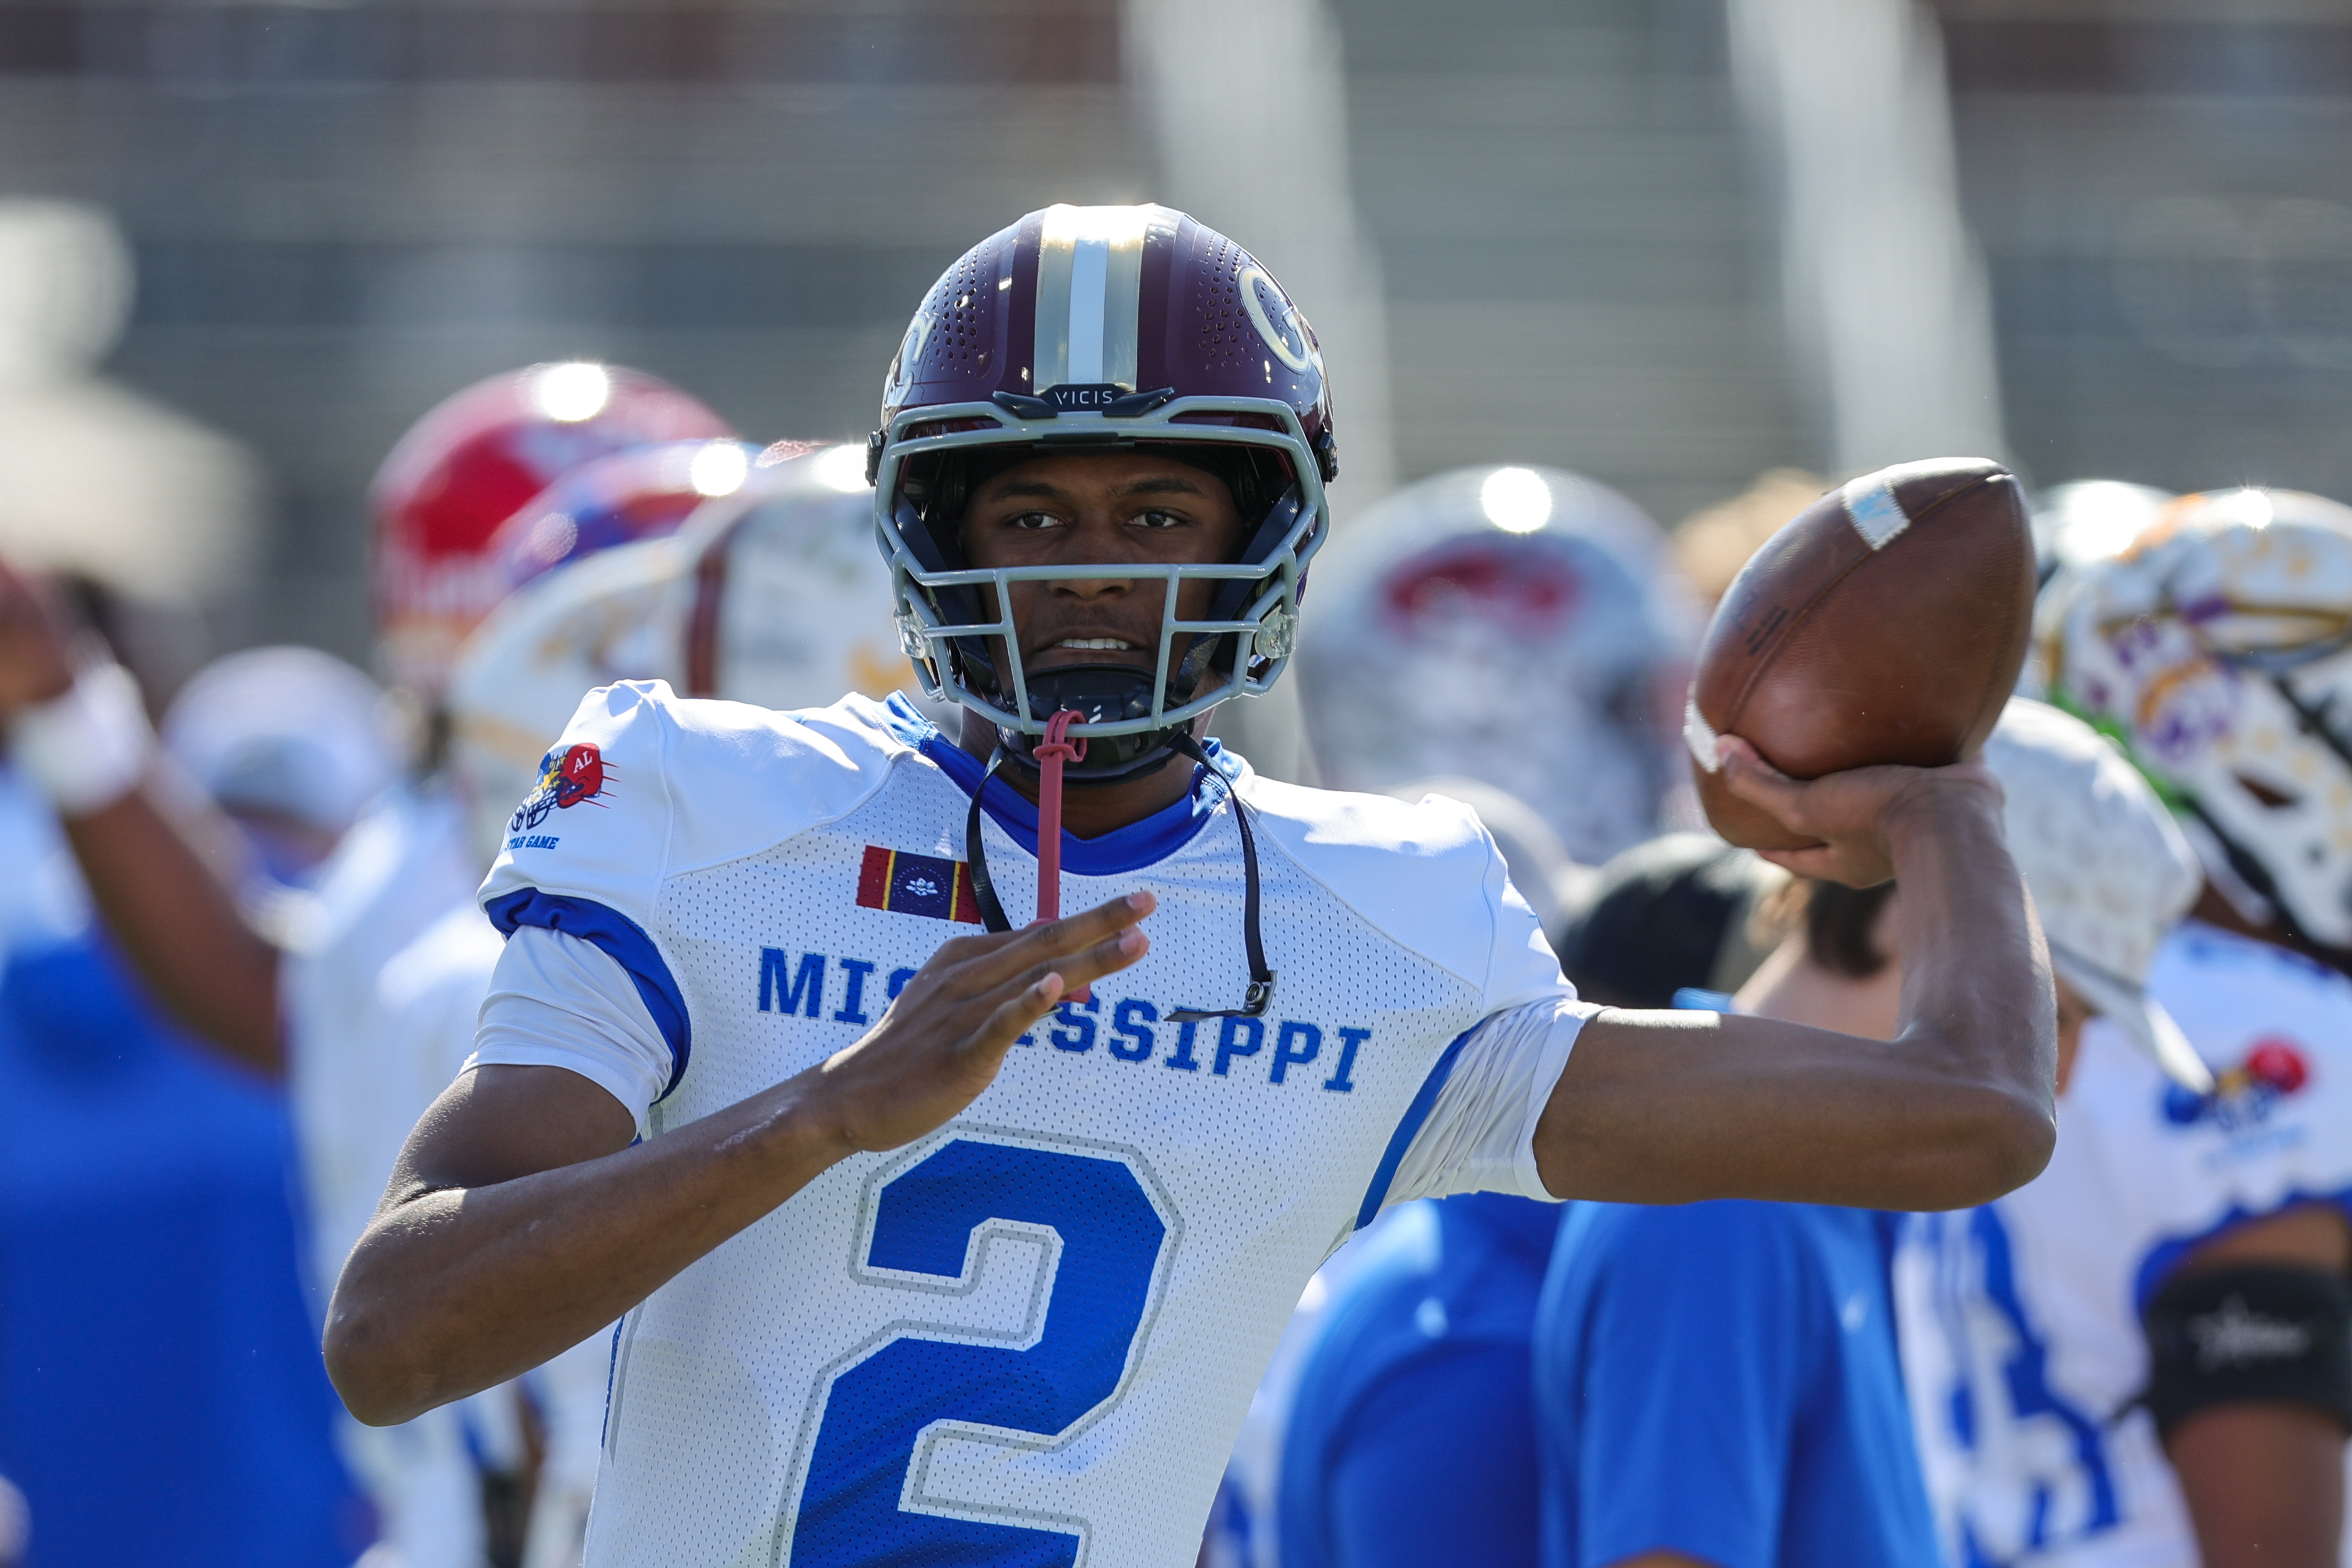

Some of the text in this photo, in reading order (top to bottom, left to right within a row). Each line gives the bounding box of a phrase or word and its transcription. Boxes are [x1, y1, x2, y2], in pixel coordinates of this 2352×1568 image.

[1055, 390, 1113, 405] VICIS
[573, 751, 592, 773] AL
[525, 835, 560, 850] GAME
[770, 1122, 1185, 1568] 2
